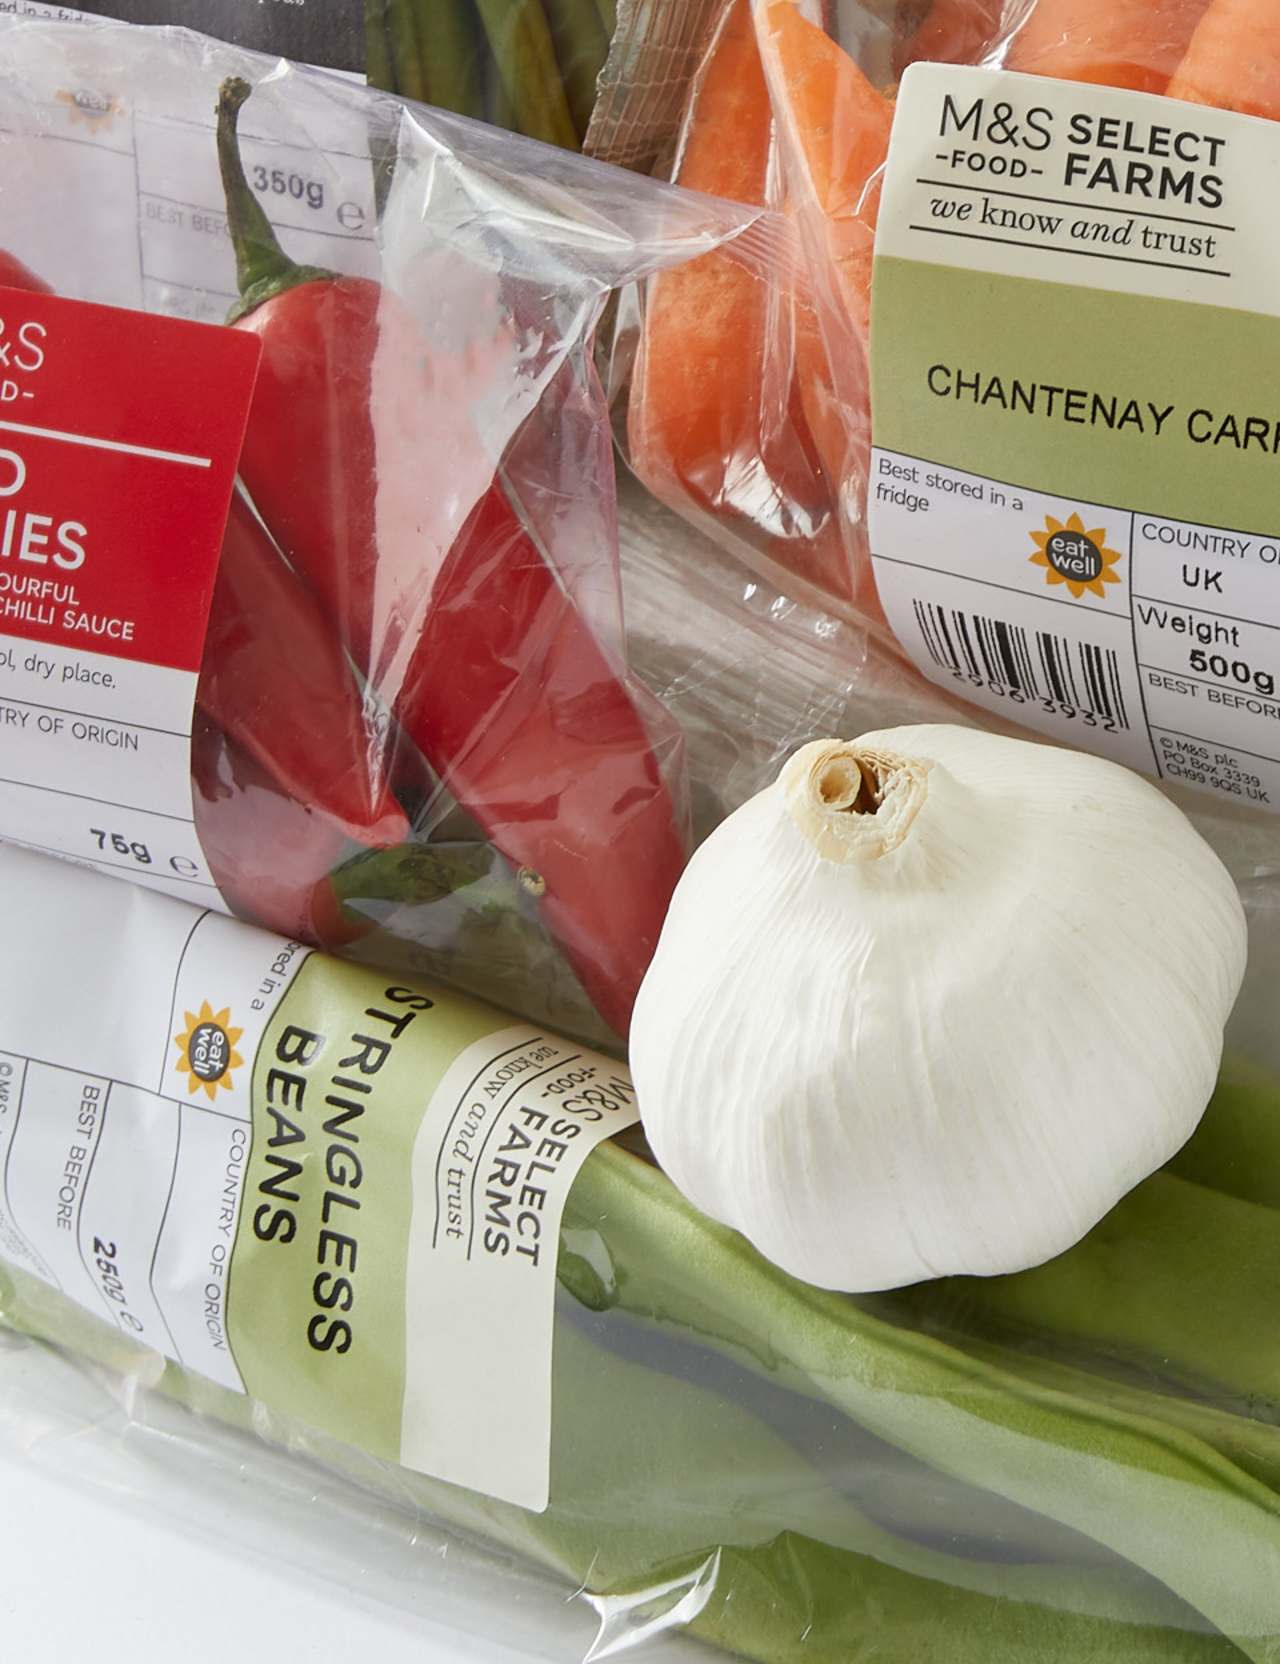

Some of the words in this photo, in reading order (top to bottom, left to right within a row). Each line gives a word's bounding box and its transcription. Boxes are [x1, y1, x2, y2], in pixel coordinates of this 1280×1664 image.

[939, 94, 1054, 151] M&S
[1067, 113, 1226, 167] SELECT
[252, 165, 324, 209] 350g
[1064, 152, 1224, 209] FARMS
[930, 197, 973, 221] we
[979, 197, 1064, 236] know
[1071, 219, 1135, 246] and
[1141, 226, 1217, 259] trust
[927, 364, 1175, 437] CHANTENAY
[876, 482, 929, 512] fridge
[878, 457, 920, 484] Best
[925, 473, 984, 500] stored
[990, 487, 1006, 506] in
[1012, 497, 1024, 511] a
[1051, 536, 1088, 558] eat
[1142, 522, 1251, 559] COUNTRY
[1051, 553, 1096, 577] well
[1182, 564, 1223, 593] UK
[63, 610, 135, 642] SAUCE
[1137, 603, 1240, 647] Weight
[24, 654, 56, 680] dry
[62, 662, 117, 690] place.
[1149, 672, 1199, 698] BEST
[1189, 649, 1275, 695] 500g
[37, 714, 65, 735] OF
[72, 722, 139, 752] ORIGIN
[1176, 740, 1209, 760] M&S
[1214, 753, 1238, 768] plc
[1163, 749, 1186, 765] PO
[1223, 767, 1261, 787] 3339
[1246, 786, 1271, 804] UK
[90, 827, 153, 865] 75g
[260, 978, 281, 995] in
[194, 1028, 212, 1074] well
[208, 1030, 225, 1072] eat
[483, 1055, 542, 1100] know
[77, 1083, 100, 1141] BEST
[452, 1102, 487, 1164] and
[253, 1024, 328, 1245] BEANS
[56, 1146, 88, 1232] BEFORE
[217, 1128, 246, 1238] COUNTRY
[307, 986, 434, 1355] STRINGLESS
[484, 1105, 549, 1257] FARMS
[446, 1166, 465, 1240] trust
[516, 1119, 582, 1267] SELECT
[210, 1245, 227, 1278] OF
[203, 1282, 225, 1352] ORIGIN
